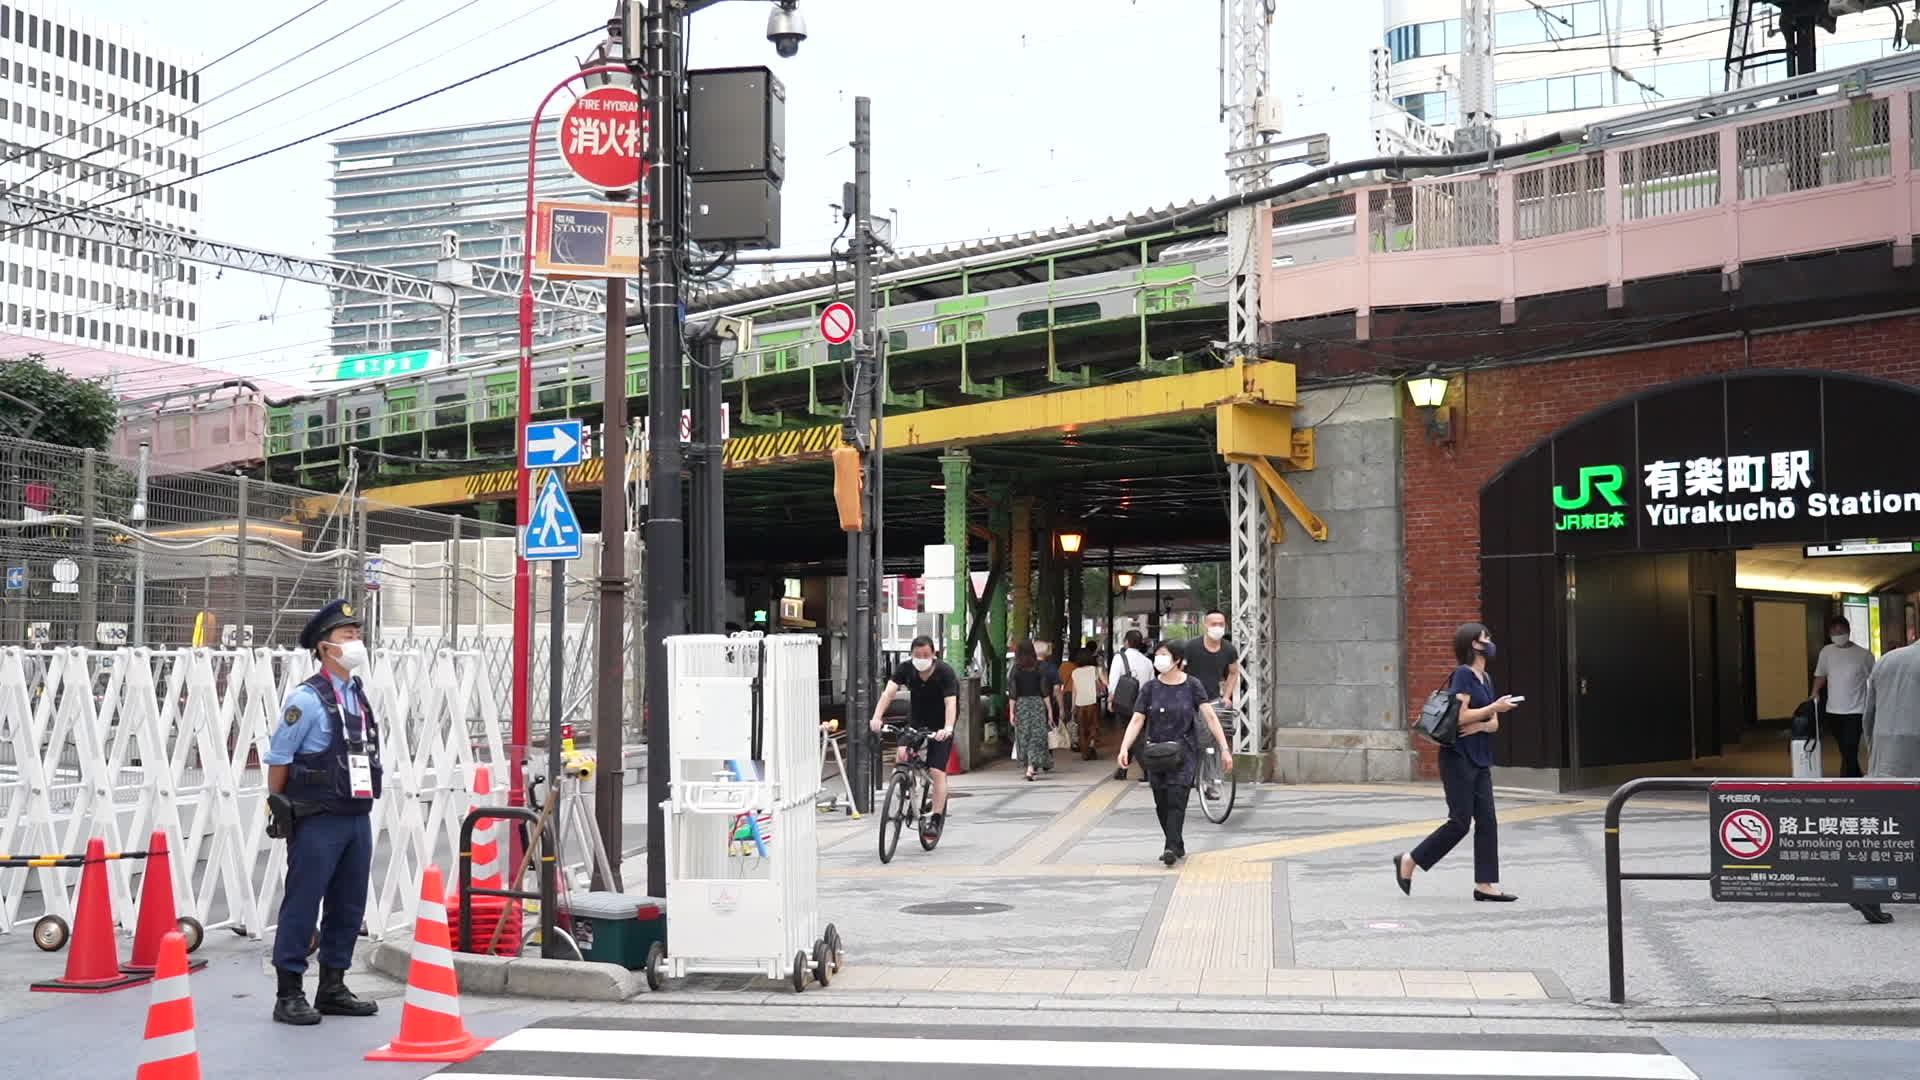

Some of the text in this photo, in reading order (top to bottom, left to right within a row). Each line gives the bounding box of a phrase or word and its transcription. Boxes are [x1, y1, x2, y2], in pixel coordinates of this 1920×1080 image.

[579, 98, 601, 111] FIRE
[554, 223, 605, 234] STATION
[1644, 449, 1812, 500] 有楽町駅
[1553, 464, 1626, 510] JR
[1645, 489, 1920, 527] Yūrakuchō Station
[1555, 511, 1625, 531] JR東日本
[1778, 817, 1900, 836] 路上喫煙禁止
[1779, 838, 1915, 850] No smoking on the street
[1893, 851, 1914, 862] 금지
